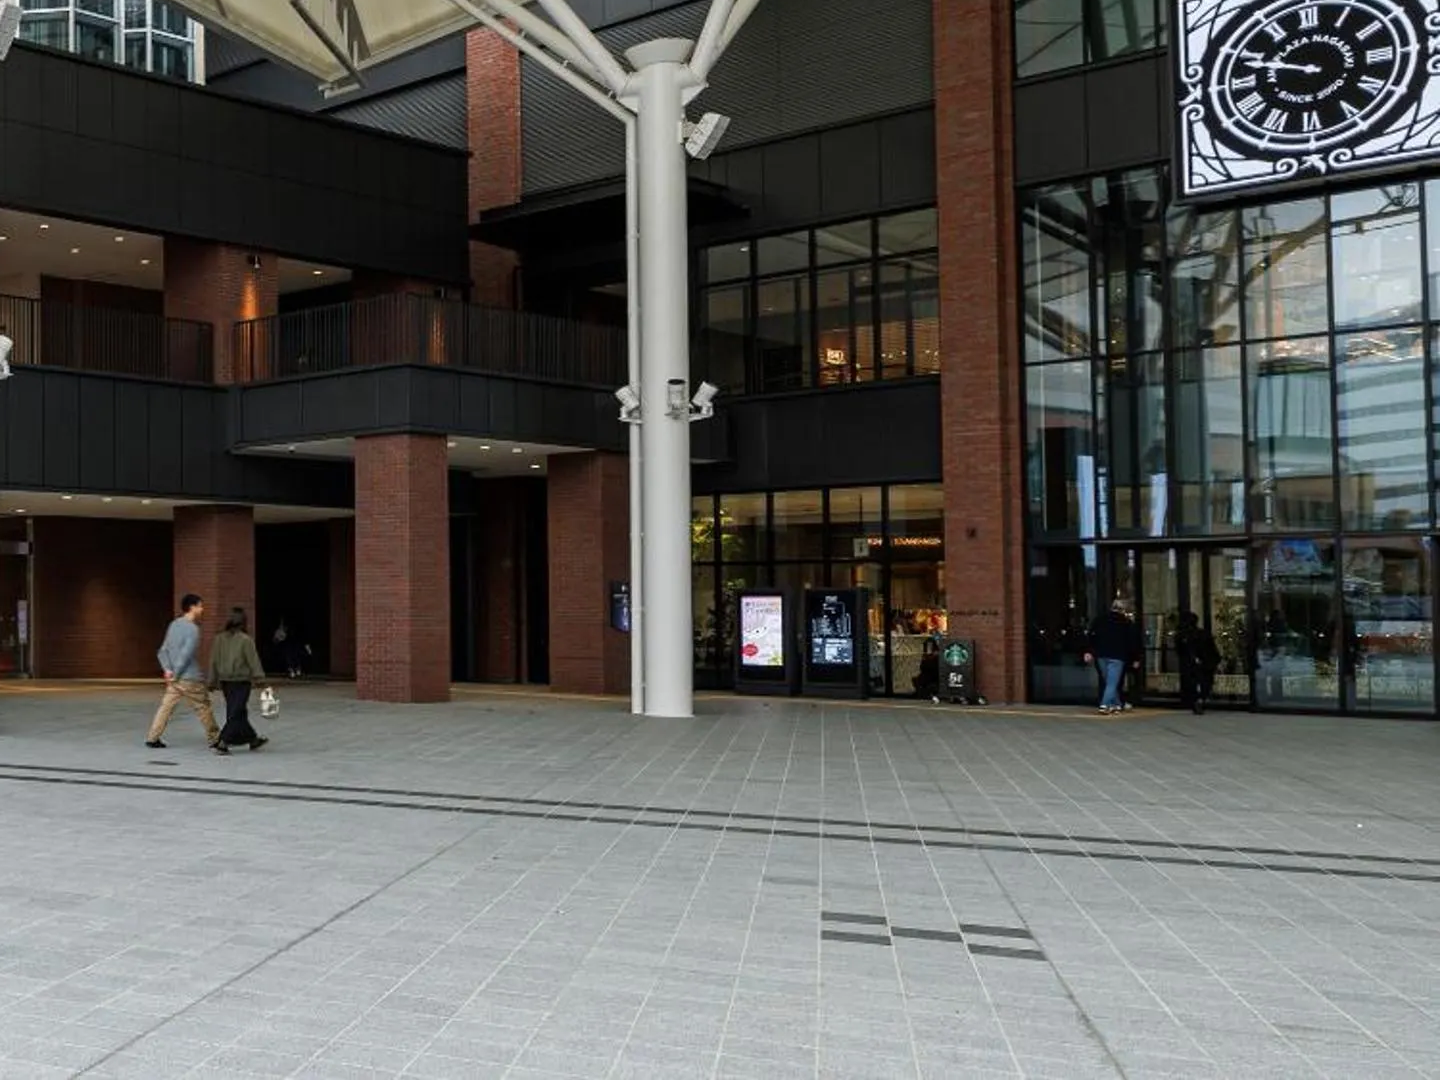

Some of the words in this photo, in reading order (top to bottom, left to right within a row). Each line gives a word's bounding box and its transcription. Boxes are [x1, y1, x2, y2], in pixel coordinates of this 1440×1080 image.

[1298, 5, 1319, 30] XII
[1334, 5, 1351, 28] I
[1262, 20, 1287, 42] XI
[1355, 19, 1383, 41] II
[1366, 44, 1394, 66] III
[1231, 74, 1257, 91] IX
[1356, 74, 1386, 97] IV
[1236, 91, 1267, 120] VIII
[1339, 99, 1361, 119] V
[1261, 107, 1289, 133] VII
[1302, 109, 1322, 133] VI
